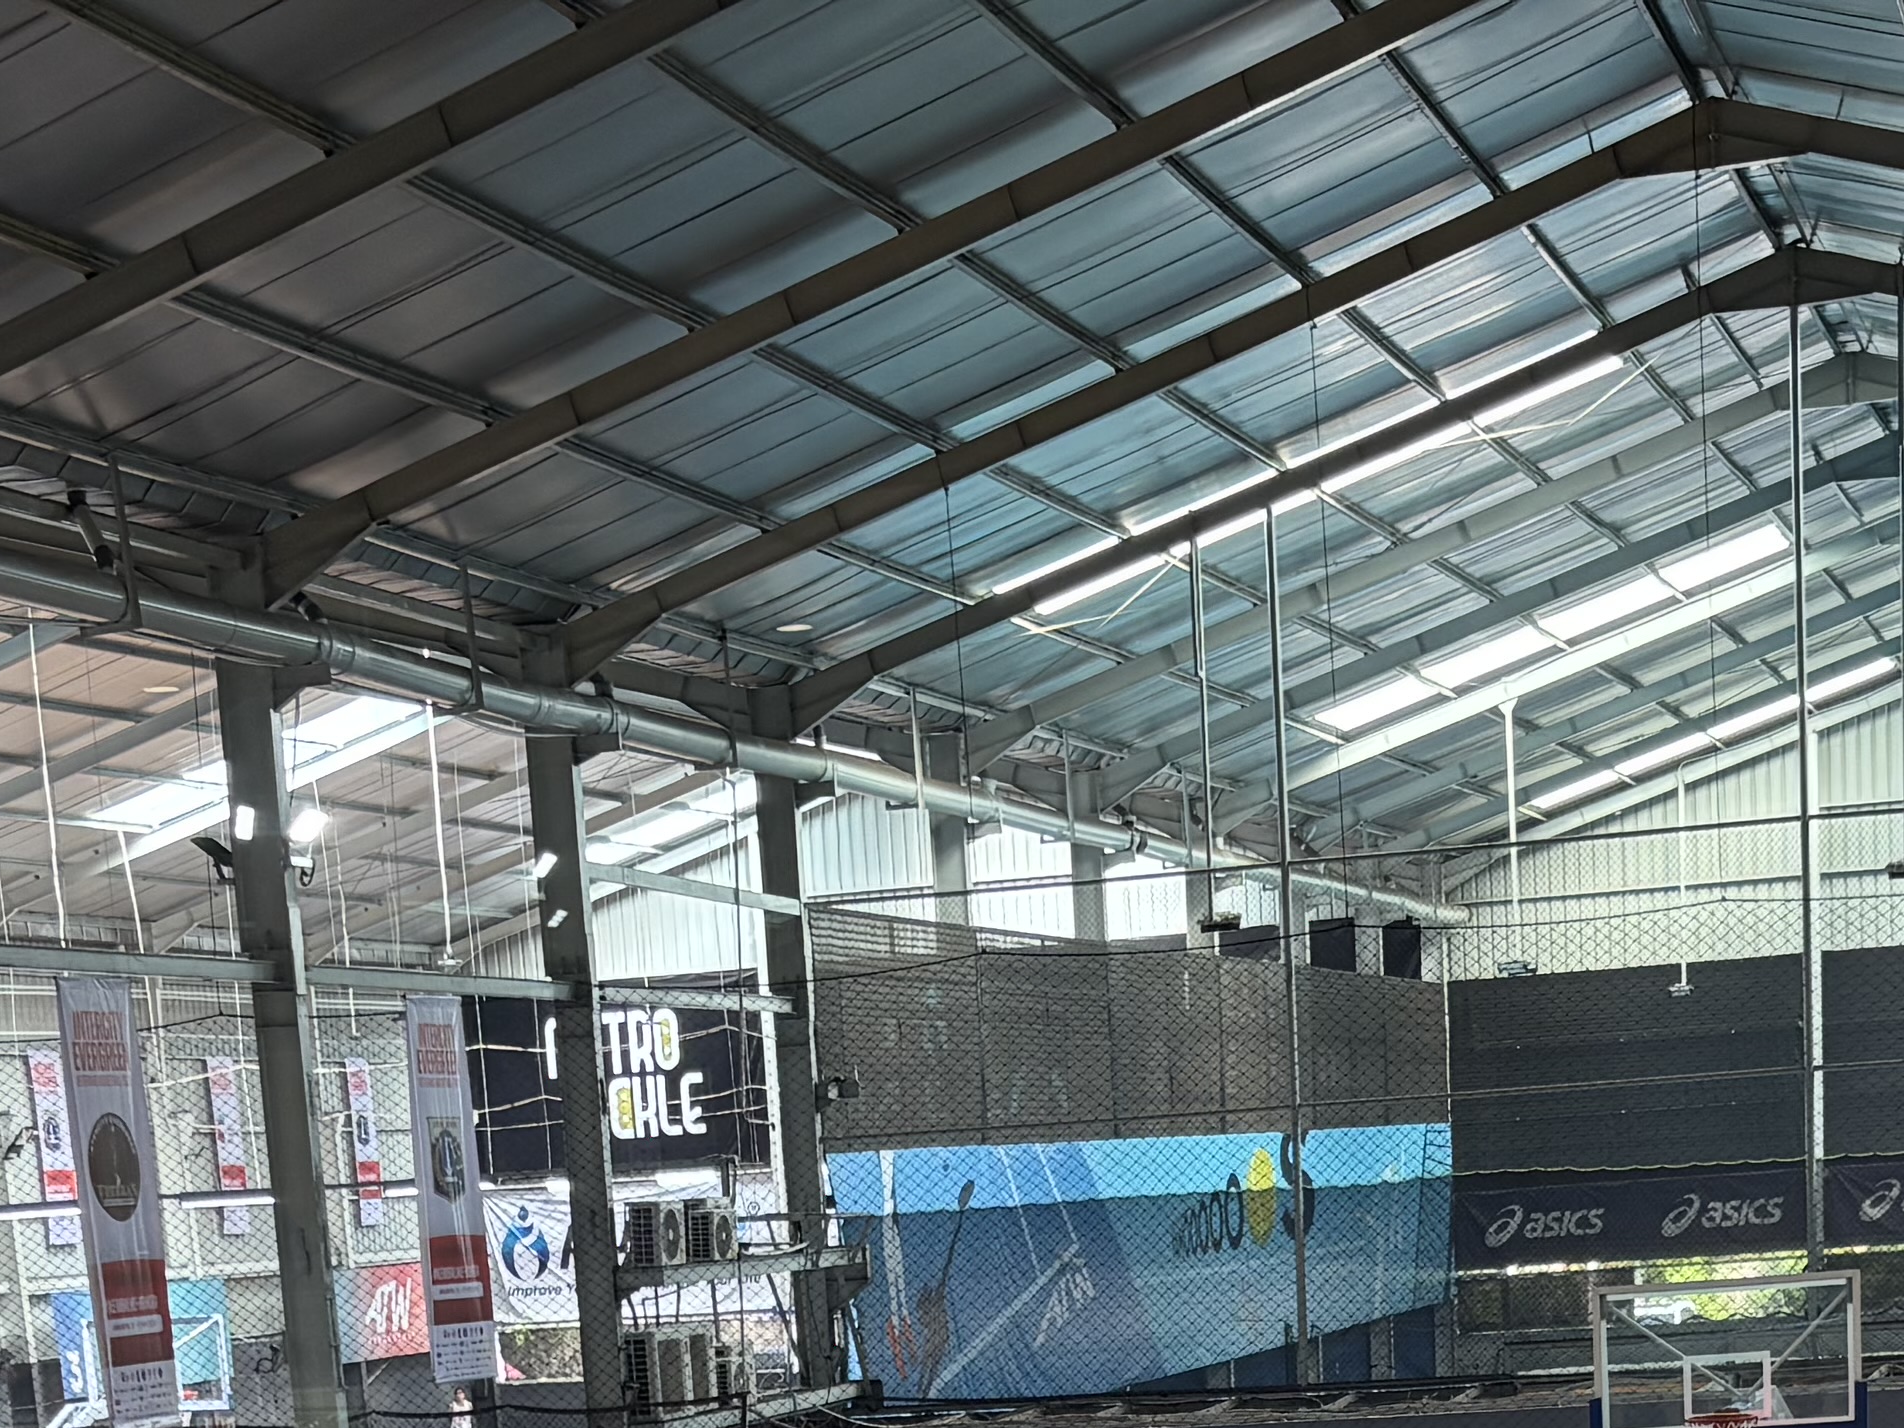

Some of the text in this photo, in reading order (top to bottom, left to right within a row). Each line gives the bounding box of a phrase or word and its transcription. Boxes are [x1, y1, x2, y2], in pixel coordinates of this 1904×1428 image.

[607, 1071, 708, 1140] CKLE
[1523, 1206, 1605, 1238] asics
[1701, 1196, 1784, 1229] asics
[365, 1277, 412, 1333] ATW
